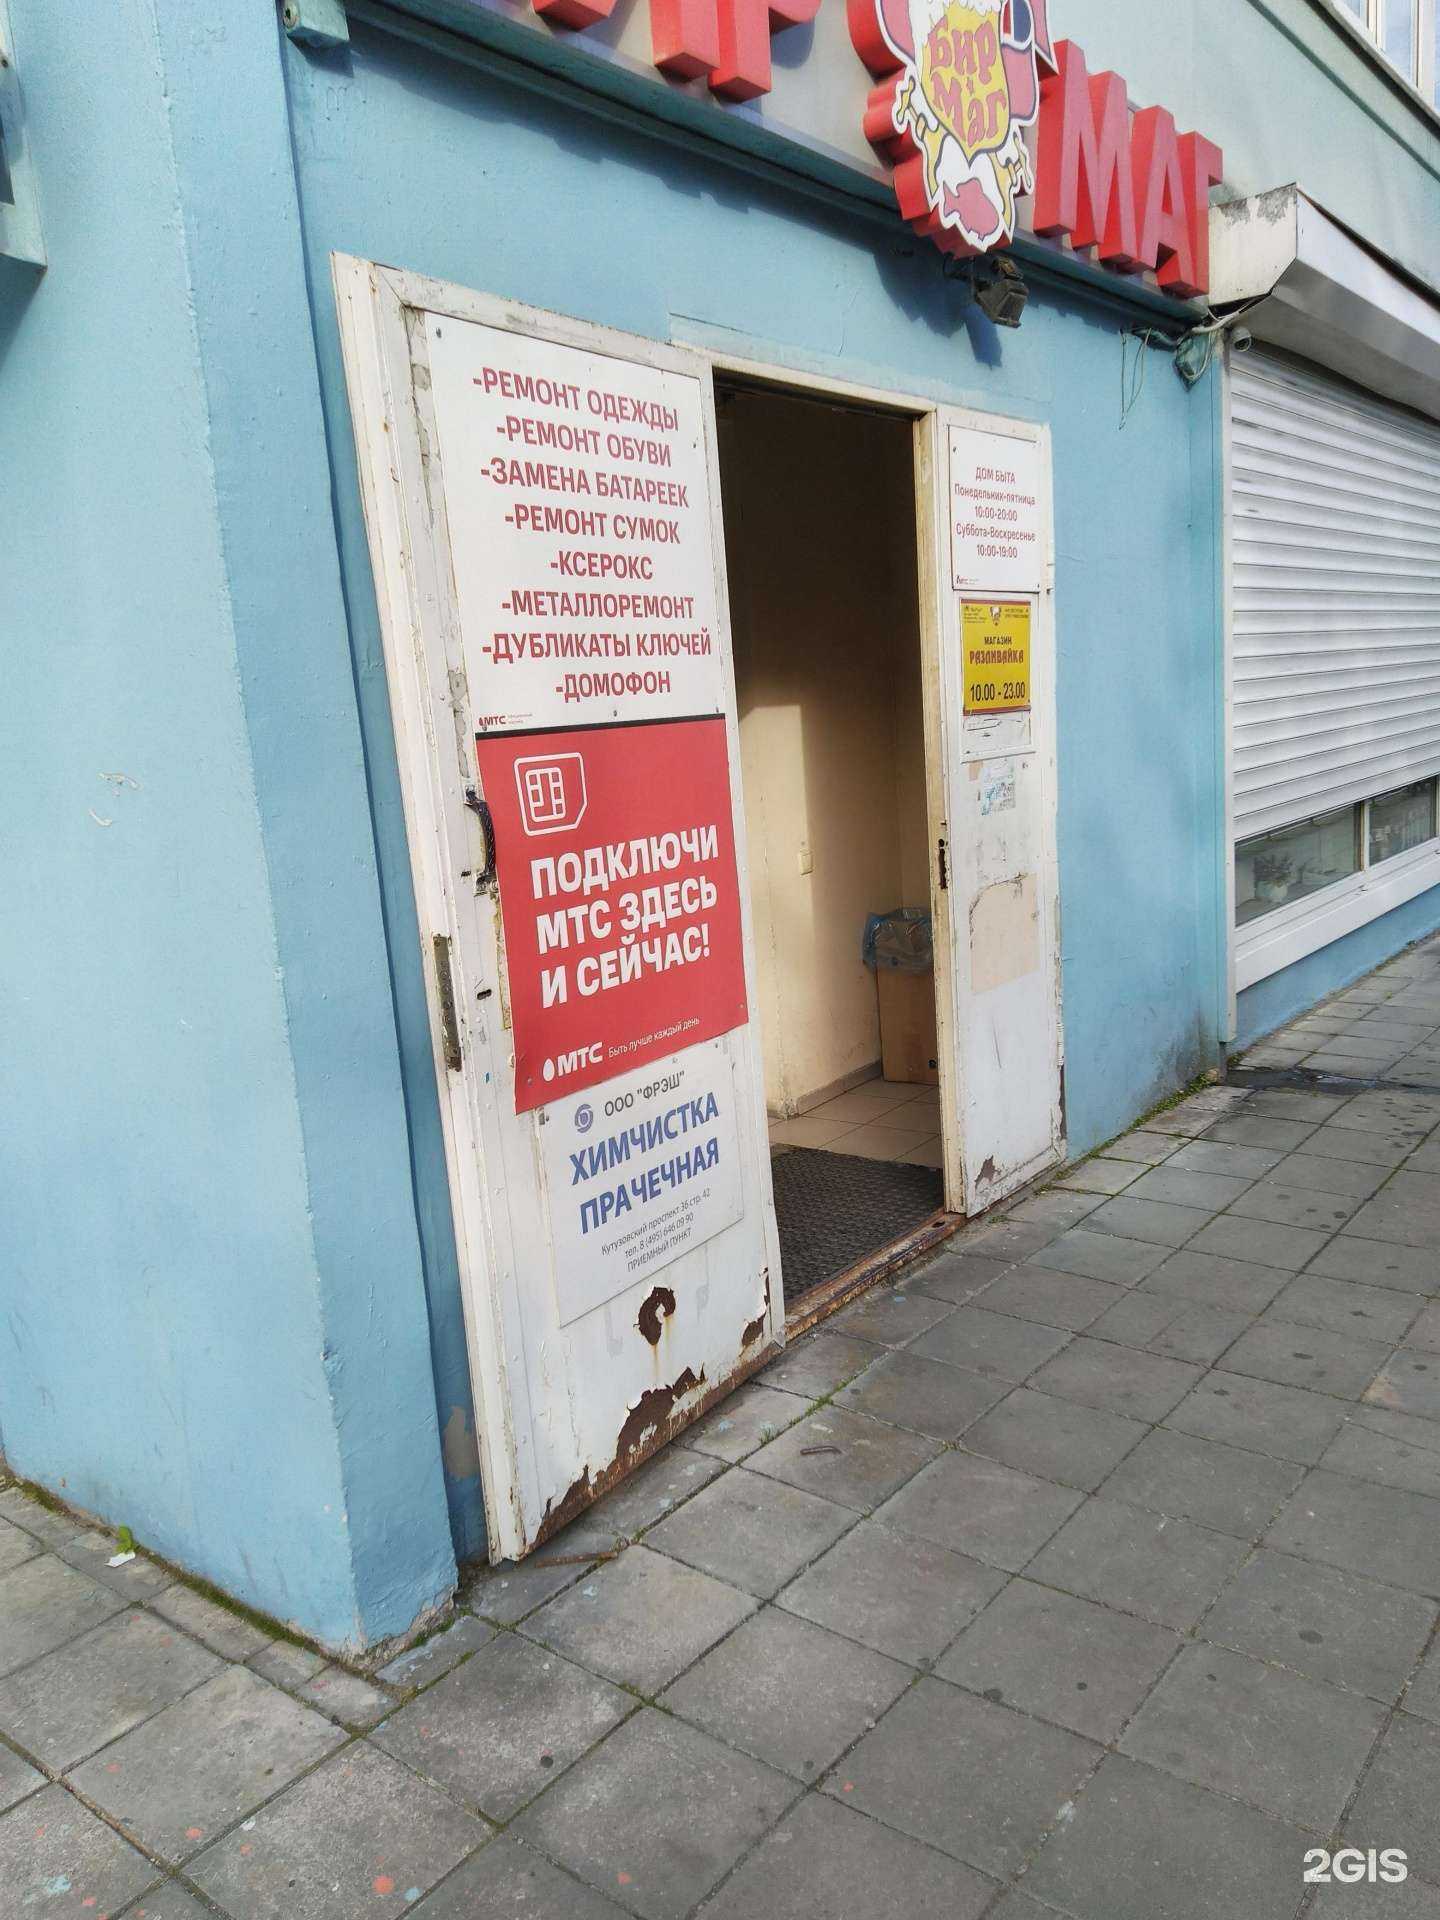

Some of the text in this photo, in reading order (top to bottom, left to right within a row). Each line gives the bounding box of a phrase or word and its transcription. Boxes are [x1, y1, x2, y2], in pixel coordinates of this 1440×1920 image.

[1036, 38, 1223, 299] МАГ
[473, 366, 679, 433] -РЕМОНТ ОДЕЖДЫ
[496, 415, 671, 467] -РЕМОНТ ОБУВИ
[481, 457, 689, 508] -ЗАМЕНА БАТАРЕЕК
[954, 483, 1036, 507] Понедельник-пятница
[976, 467, 1016, 485] ДОМ БЫТА
[504, 503, 681, 544] -РЕМОНТ СУМОК
[975, 506, 1018, 522] 10:00-20:00
[550, 551, 653, 580] -КСЕРОКС
[977, 545, 1018, 558] 10:00-19:00
[502, 590, 694, 618] -МЕТАЛЛОРЕМОНТ
[482, 627, 711, 664] -ДУБЛИКАТЫ КЛЮЧЕЙ
[984, 636, 1012, 645] МАГАЗИН
[555, 671, 671, 702] -ДОМОФОН
[970, 683, 995, 701] 10.00
[1003, 682, 1025, 699] 23.00
[484, 715, 506, 726] МТС
[530, 825, 719, 899] ПОДКЛЮЧИ
[536, 875, 717, 955] МТС ЗДЕСЬ
[540, 924, 711, 1009] И СЕЙЧАС!
[558, 1017, 700, 1077] МТС Быть лучше каждый день
[604, 1070, 685, 1117] ООО "ФРЭШ"
[569, 1092, 719, 1186] ХИМЧИСТКА
[579, 1137, 720, 1235] ПРАЧЕЧНАЯ
[601, 1223, 647, 1256] Кутузовский
[648, 1206, 680, 1230] проспект
[680, 1200, 689, 1212] 36
[625, 1212, 694, 1258] тел. 8 (495) 646 09 90
[627, 1227, 692, 1272] ПРИЕМНЫЙ ПУНКТ
